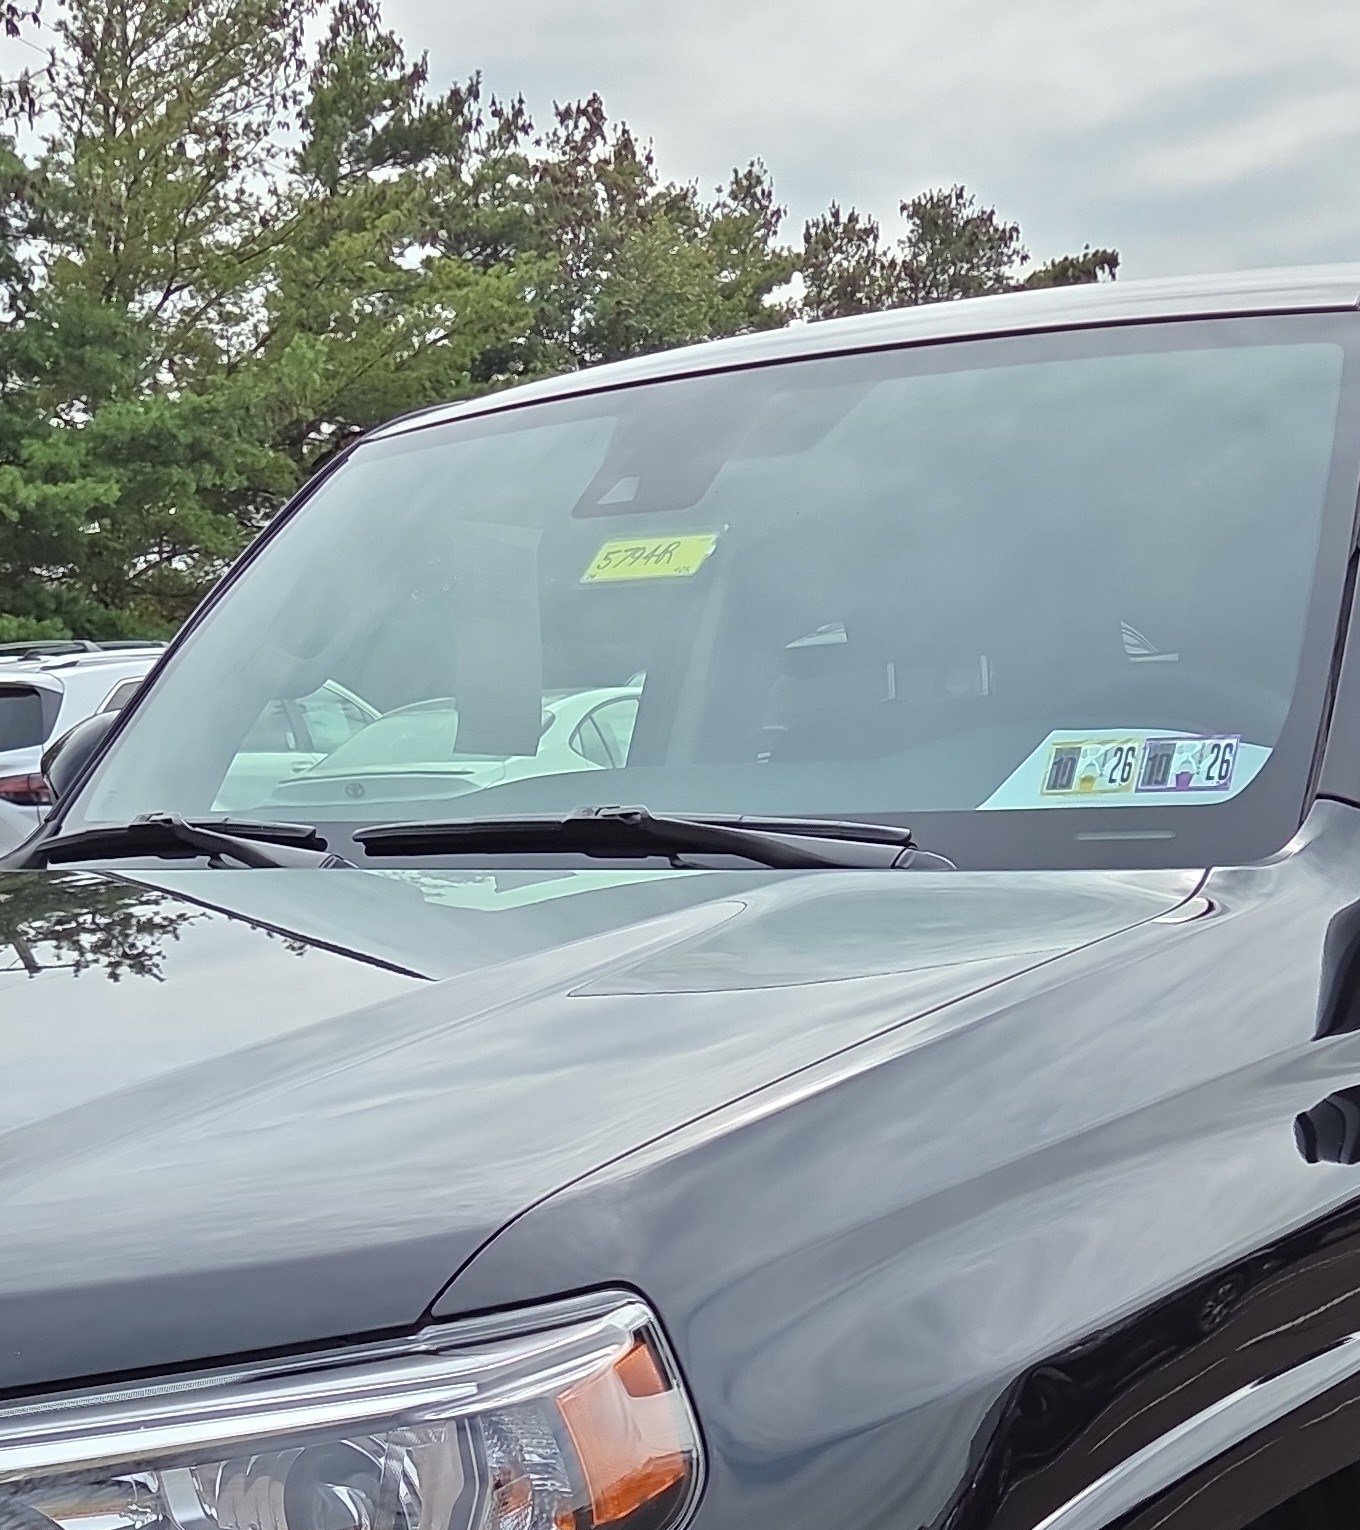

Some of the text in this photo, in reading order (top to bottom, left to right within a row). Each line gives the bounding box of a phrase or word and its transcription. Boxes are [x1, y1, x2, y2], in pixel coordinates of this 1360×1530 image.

[1049, 756, 1078, 790] 10
[1107, 746, 1136, 784] 26
[1143, 753, 1172, 786] 10
[1205, 742, 1234, 781] 26
